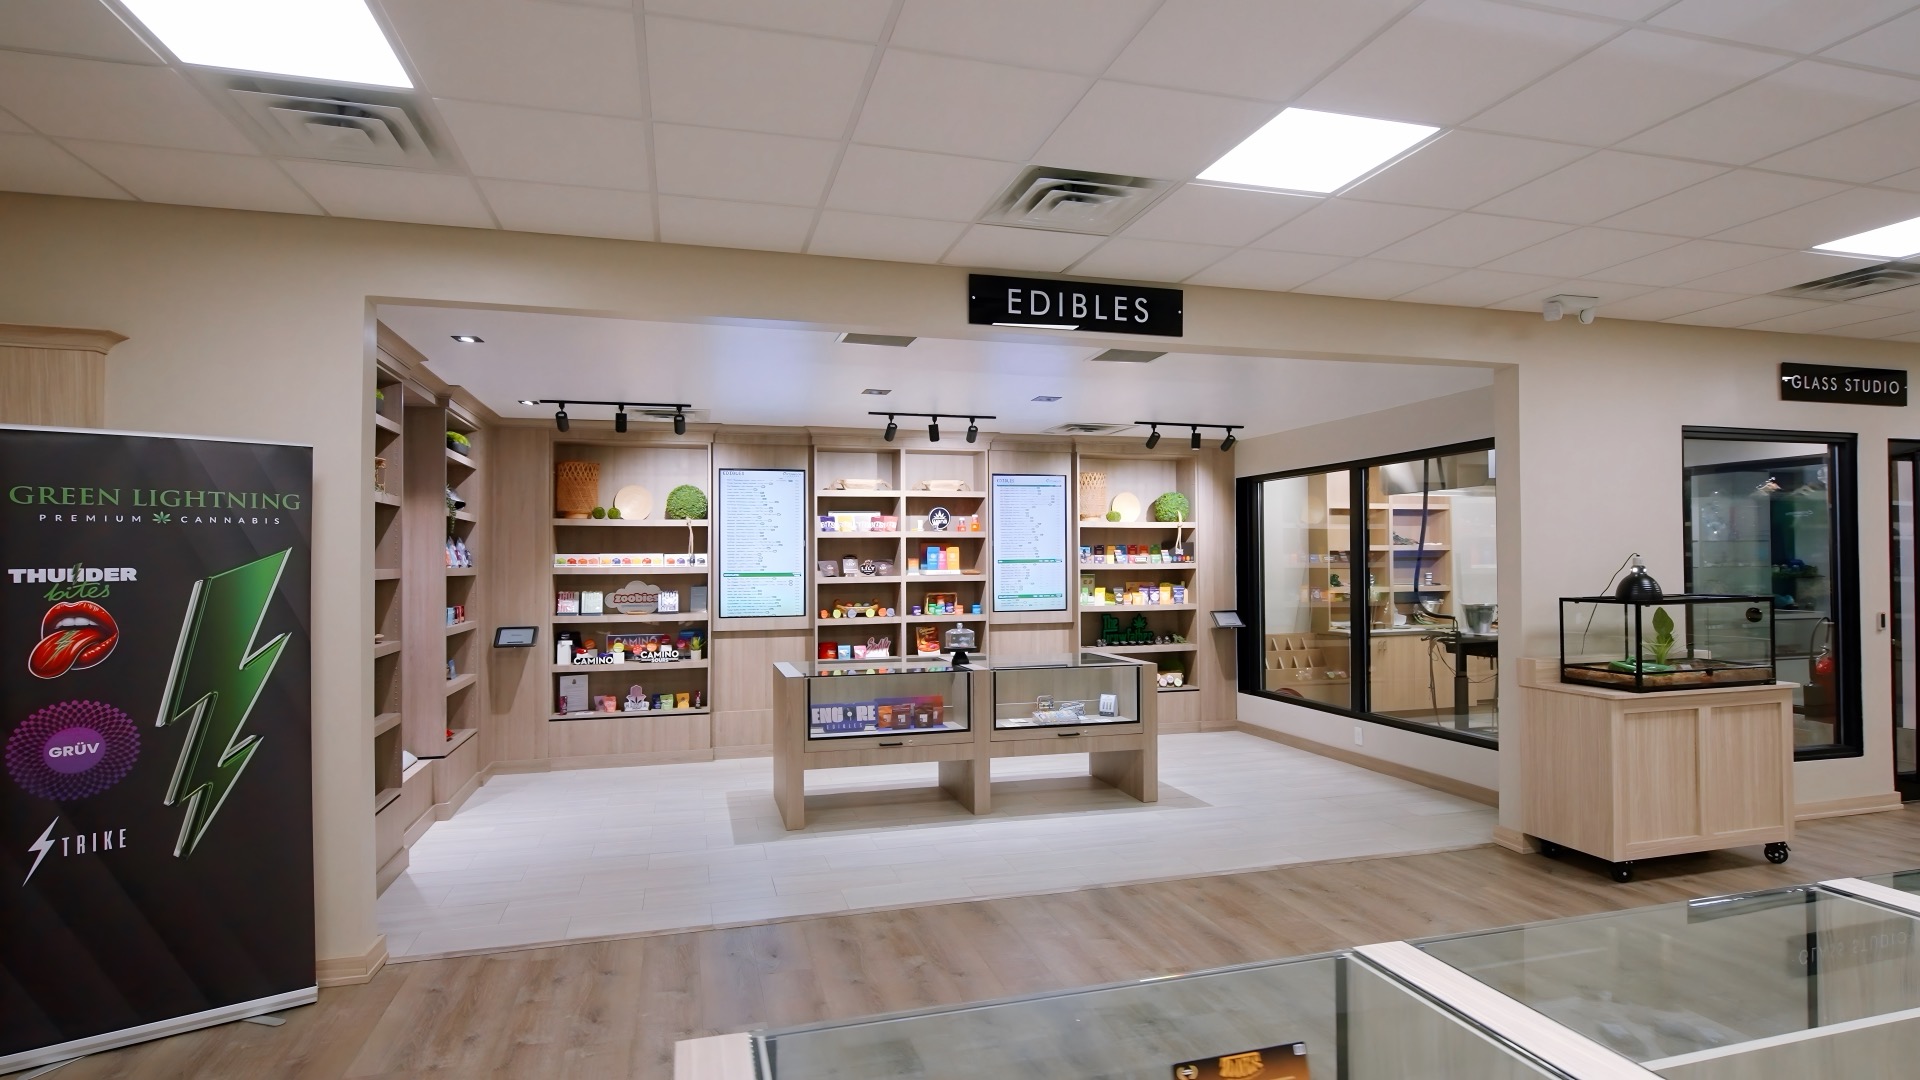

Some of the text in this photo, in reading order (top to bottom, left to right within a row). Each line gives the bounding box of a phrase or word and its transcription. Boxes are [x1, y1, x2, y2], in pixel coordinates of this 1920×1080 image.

[1008, 288, 1149, 323] EDIBLES
[1791, 375, 1900, 394] GLASS STUDIO
[9, 485, 301, 510] GREEN LIGHTNING
[39, 513, 281, 525] PREMIUM CANNABIS
[8, 567, 137, 583] THUNDER
[43, 582, 110, 601] bites
[573, 656, 614, 665] CAMINO
[640, 650, 679, 659] CAMINO
[48, 741, 100, 758] GRÜV
